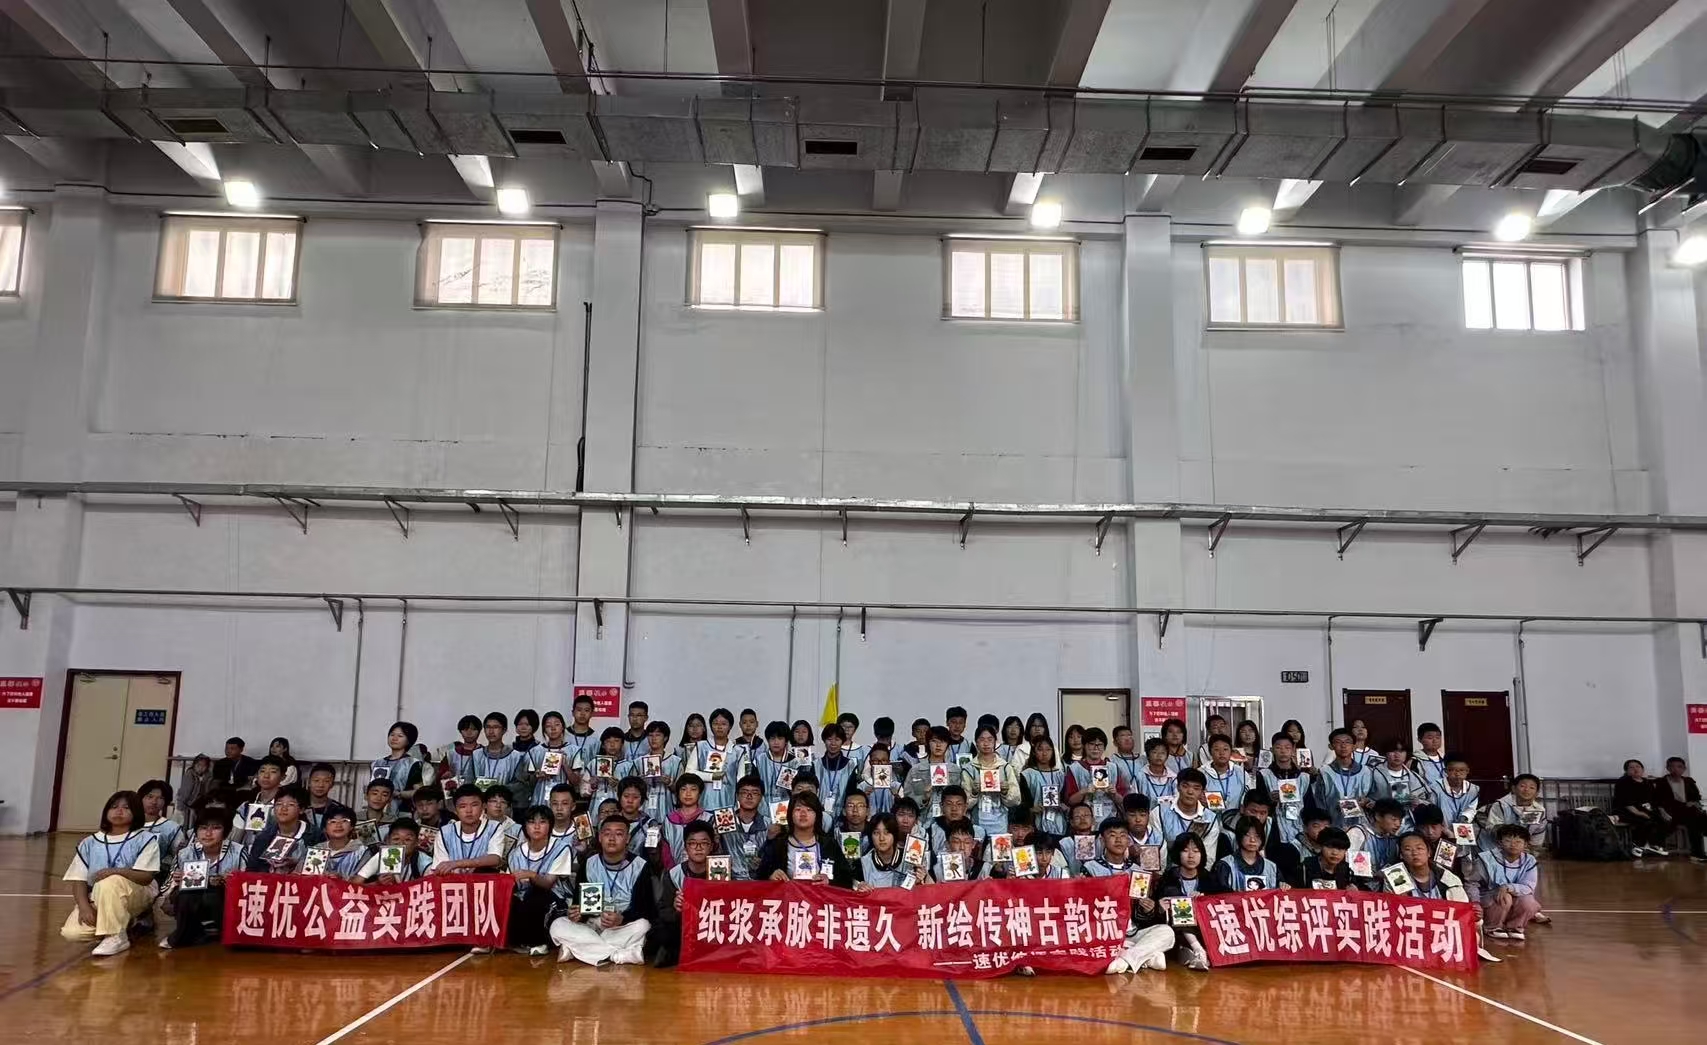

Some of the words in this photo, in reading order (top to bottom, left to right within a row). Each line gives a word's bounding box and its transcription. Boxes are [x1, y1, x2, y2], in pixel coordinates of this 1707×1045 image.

[237, 879, 500, 941] 速优公益实践团队
[698, 898, 901, 952] 纸浆承脉非遗久
[917, 896, 1123, 950] 新绘传神古韵流
[1210, 895, 1464, 963] 速优综评实践活动
